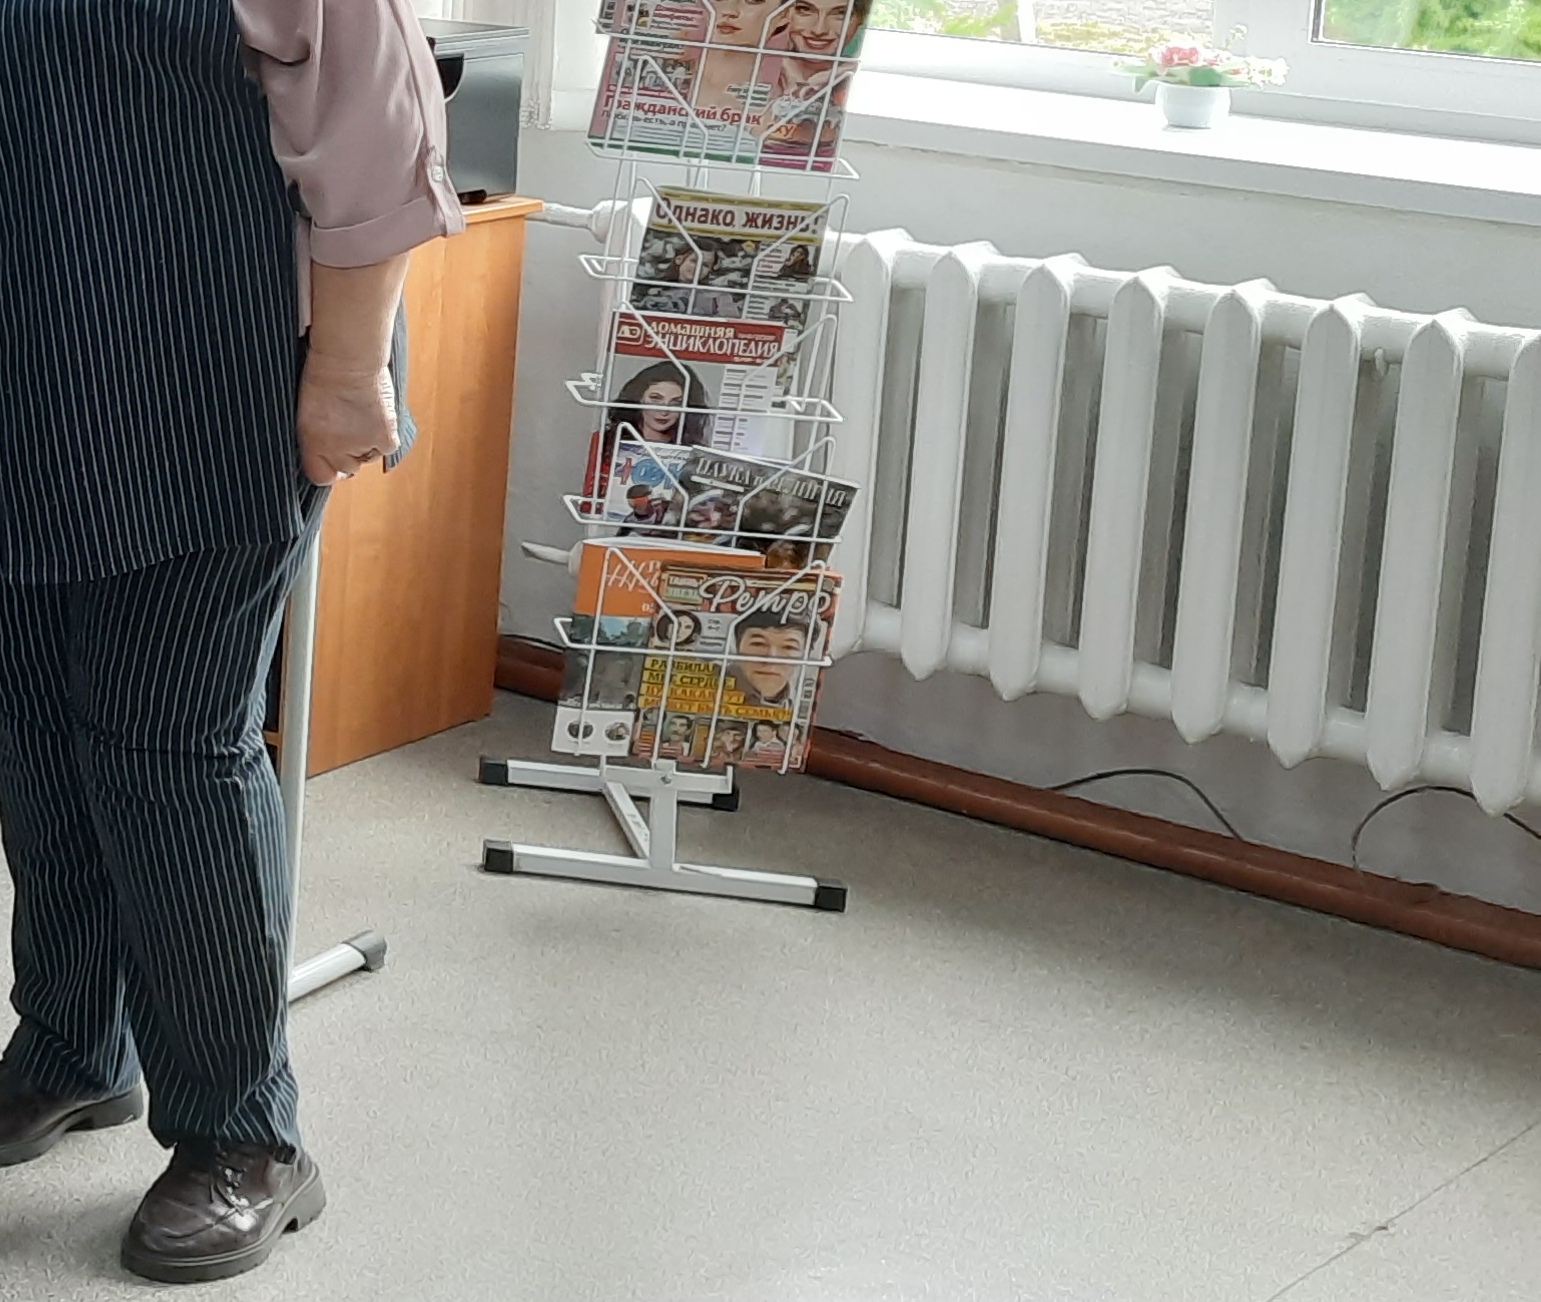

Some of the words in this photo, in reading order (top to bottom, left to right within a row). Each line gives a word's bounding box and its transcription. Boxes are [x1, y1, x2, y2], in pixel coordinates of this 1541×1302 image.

[603, 95, 716, 121] Гражданский
[719, 106, 762, 126] брак
[742, 211, 822, 235] жизнь!
[644, 332, 780, 359] ЭНЦИКЛОПЕДИЯ
[699, 576, 831, 623] Ретро
